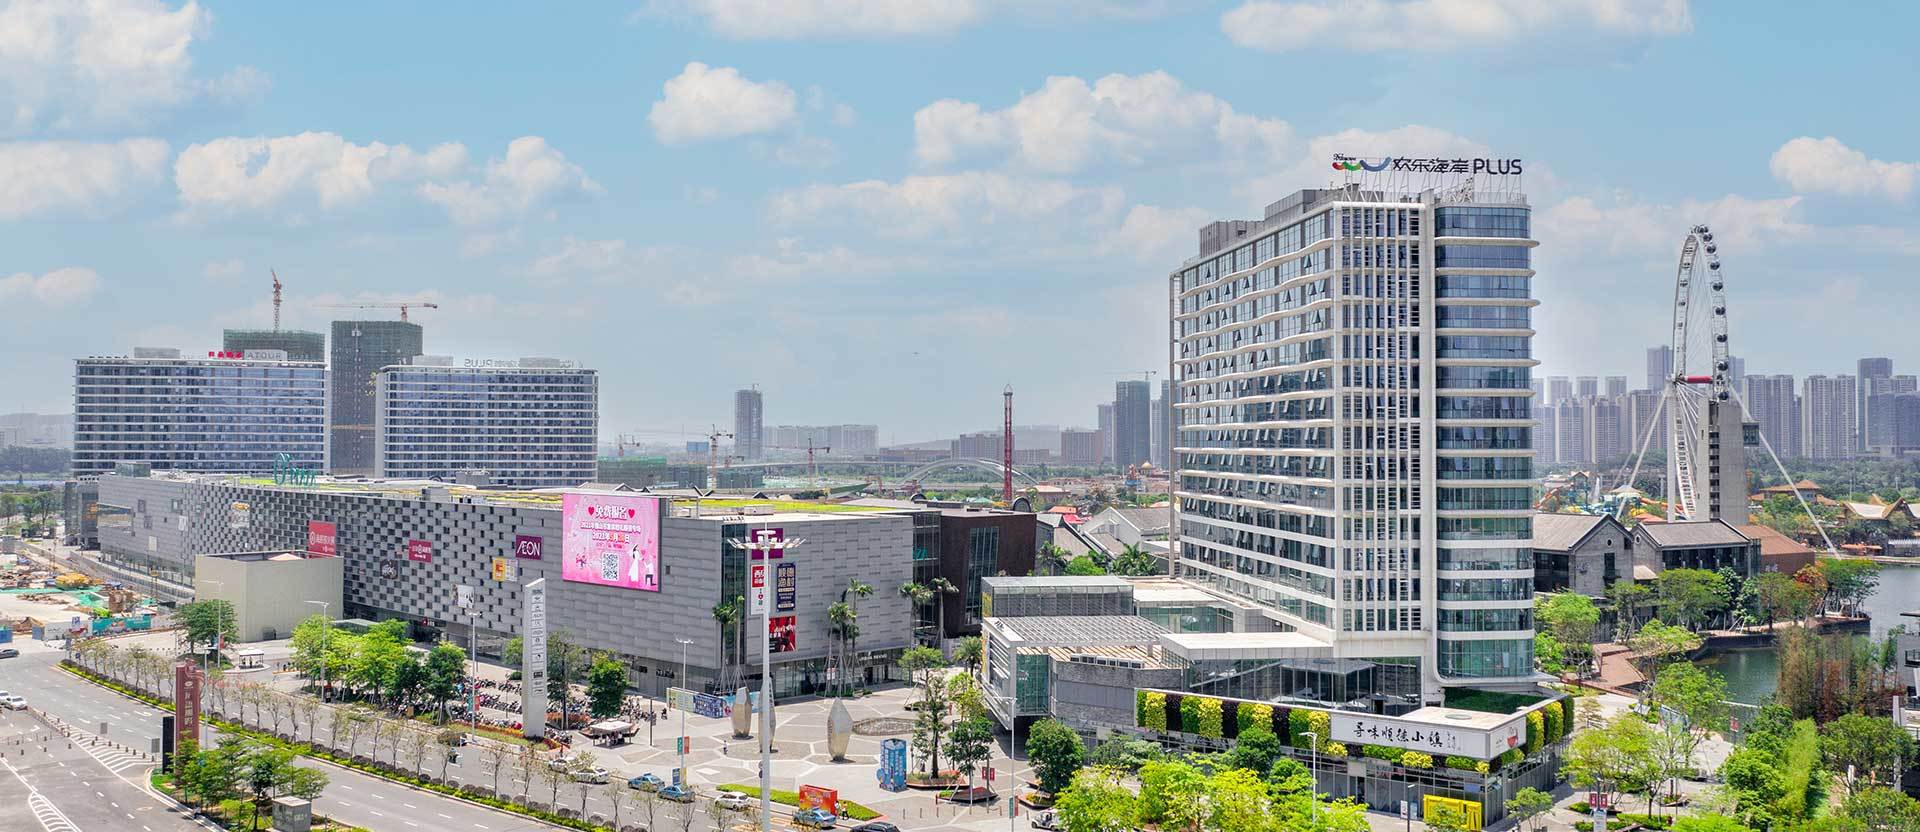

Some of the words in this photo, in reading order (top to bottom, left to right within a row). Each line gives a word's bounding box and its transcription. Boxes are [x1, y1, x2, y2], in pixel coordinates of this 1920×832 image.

[1393, 157, 1469, 173] 欢乐海岸
[1473, 158, 1522, 174] PLUS
[596, 505, 627, 519] 免费报名
